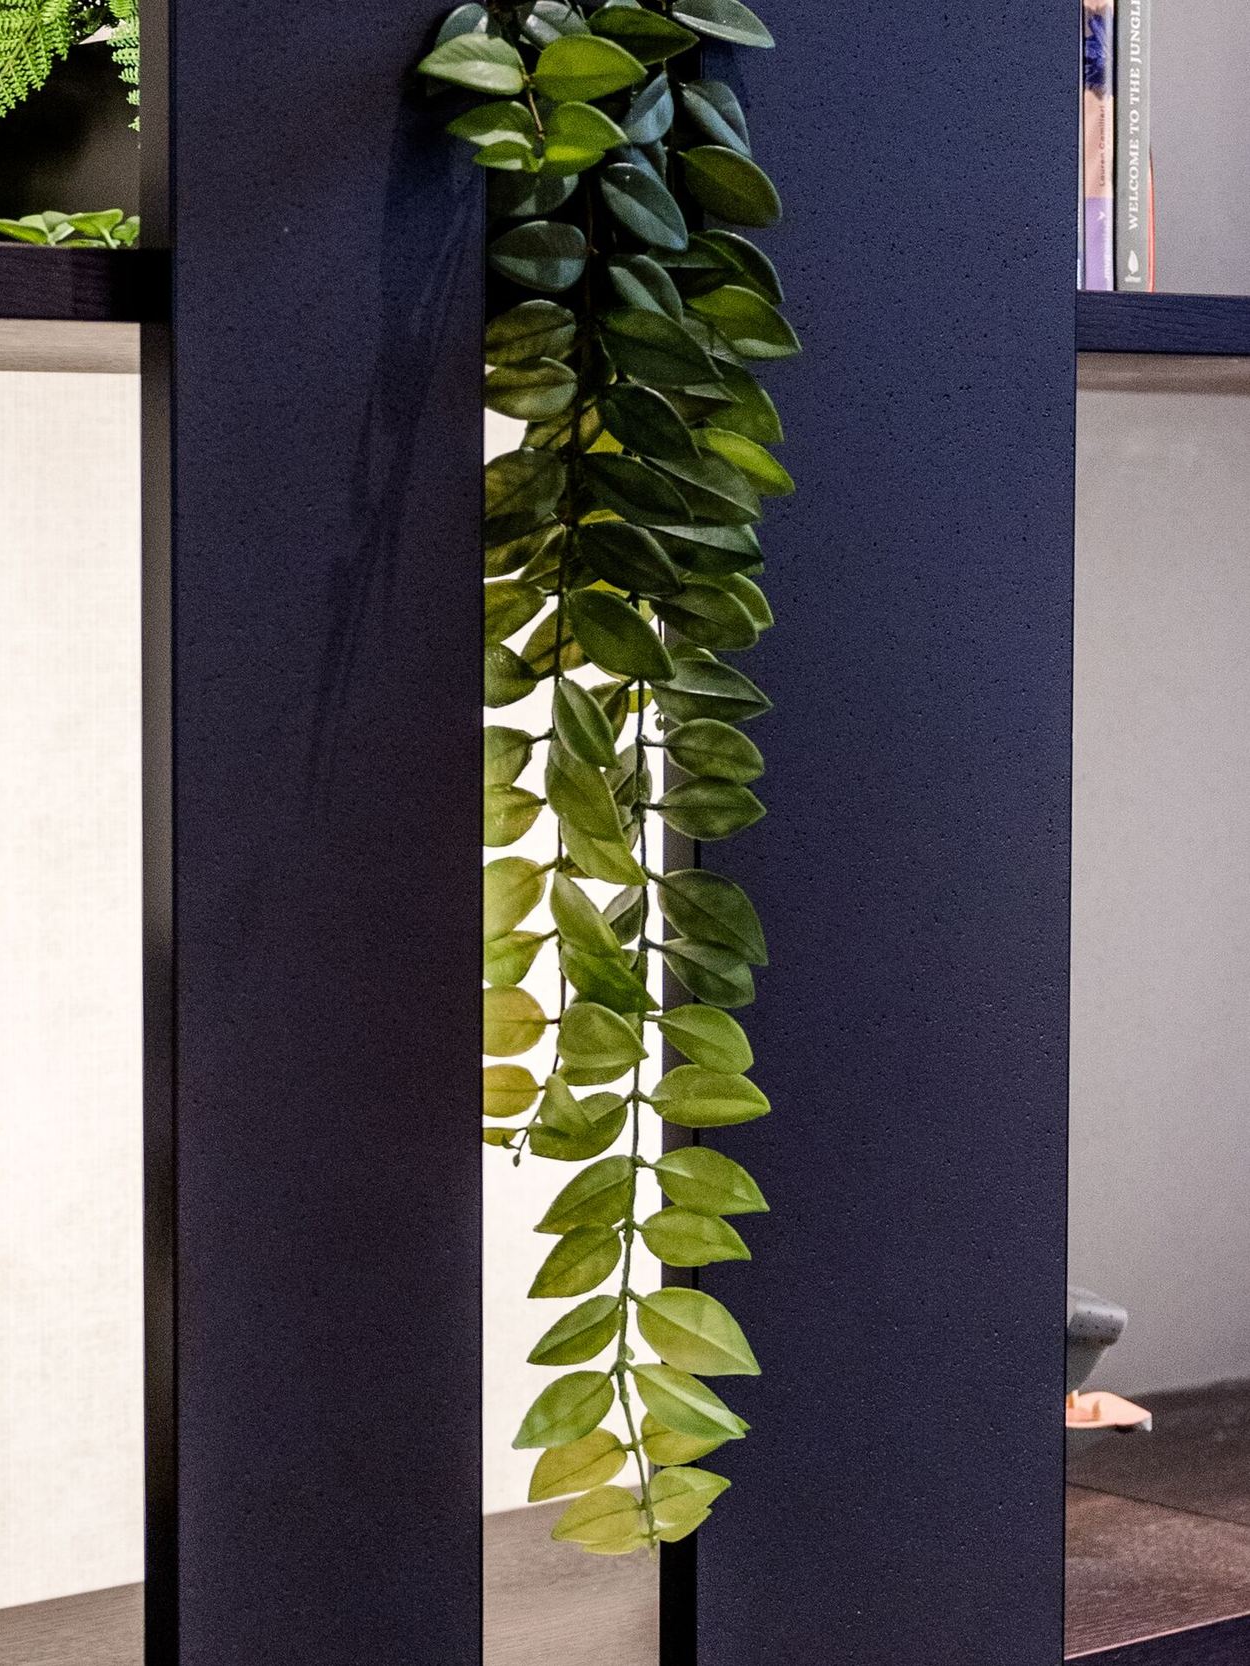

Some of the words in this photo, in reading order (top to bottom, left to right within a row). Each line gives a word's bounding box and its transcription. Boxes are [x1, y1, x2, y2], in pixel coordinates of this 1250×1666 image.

[1129, 69, 1141, 106] THE
[1129, 109, 1141, 135] TO
[1127, 139, 1140, 231] WELCOME
